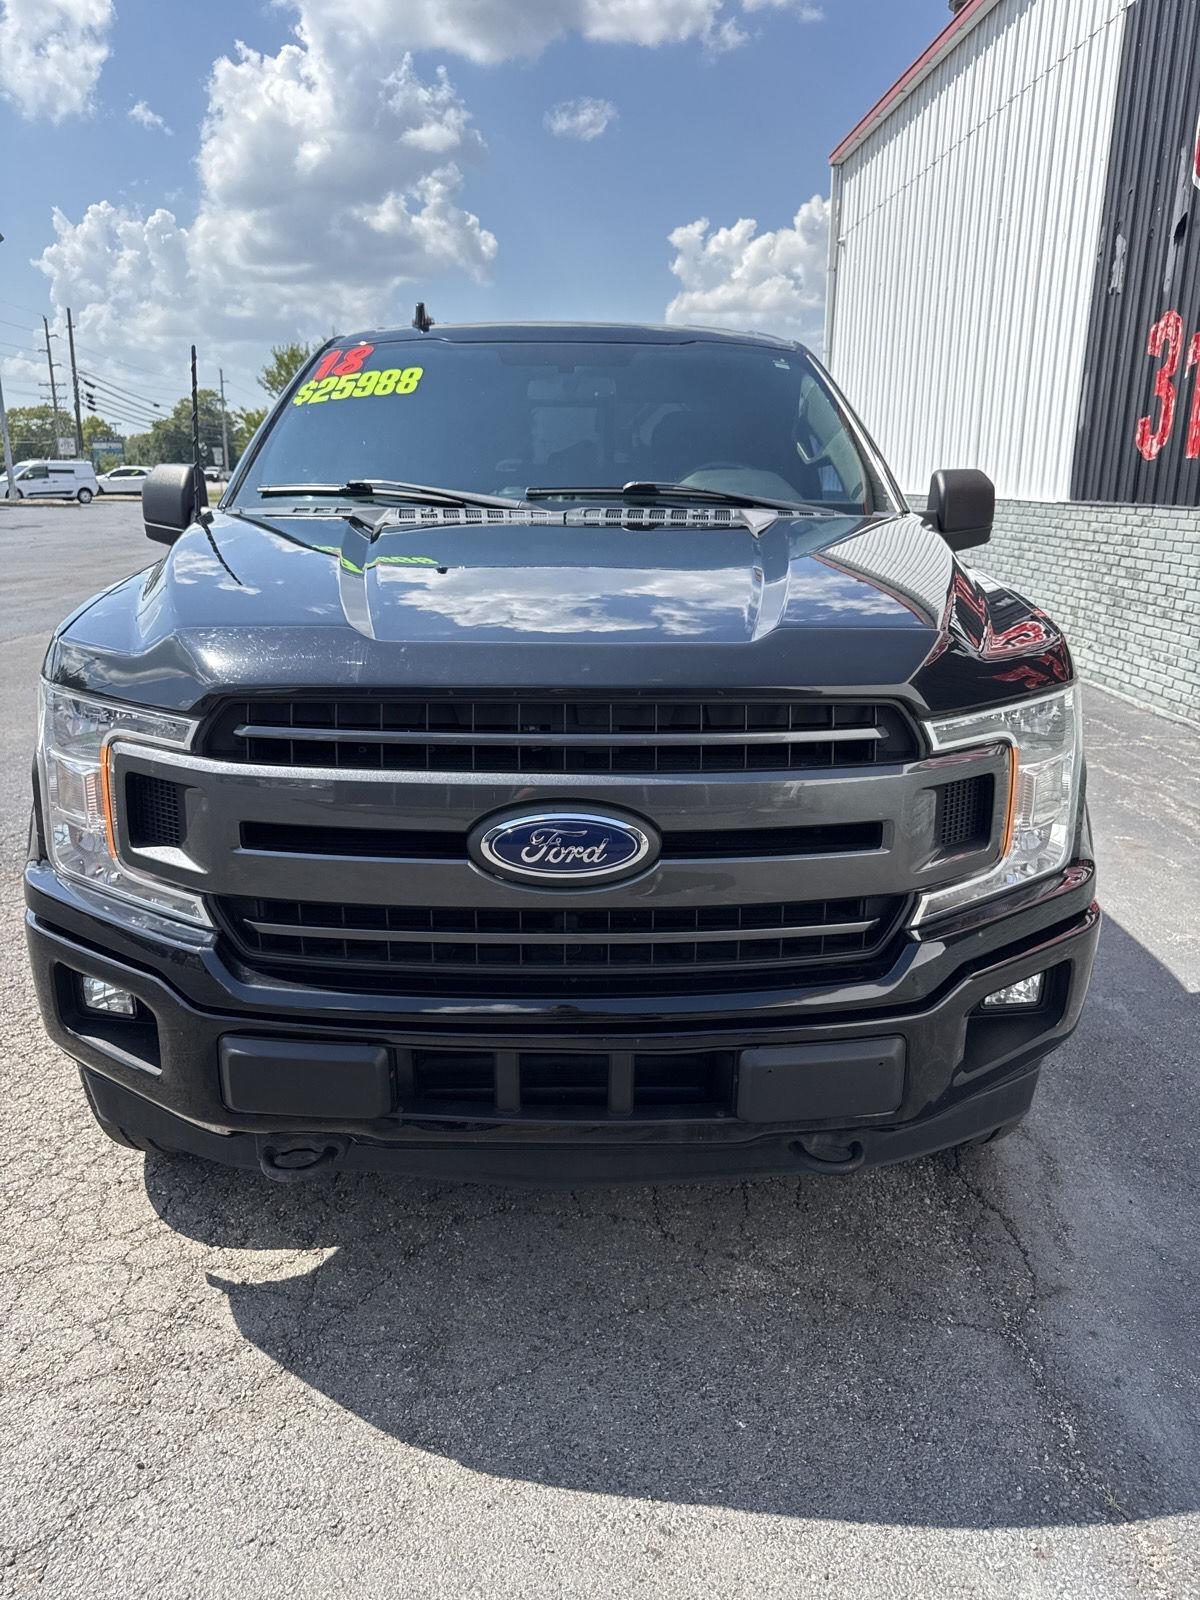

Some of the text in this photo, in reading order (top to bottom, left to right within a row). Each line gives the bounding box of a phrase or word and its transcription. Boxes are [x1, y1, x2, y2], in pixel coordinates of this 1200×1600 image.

[313, 344, 375, 381] 18
[293, 367, 424, 406] $25988
[520, 828, 609, 863] Ford
